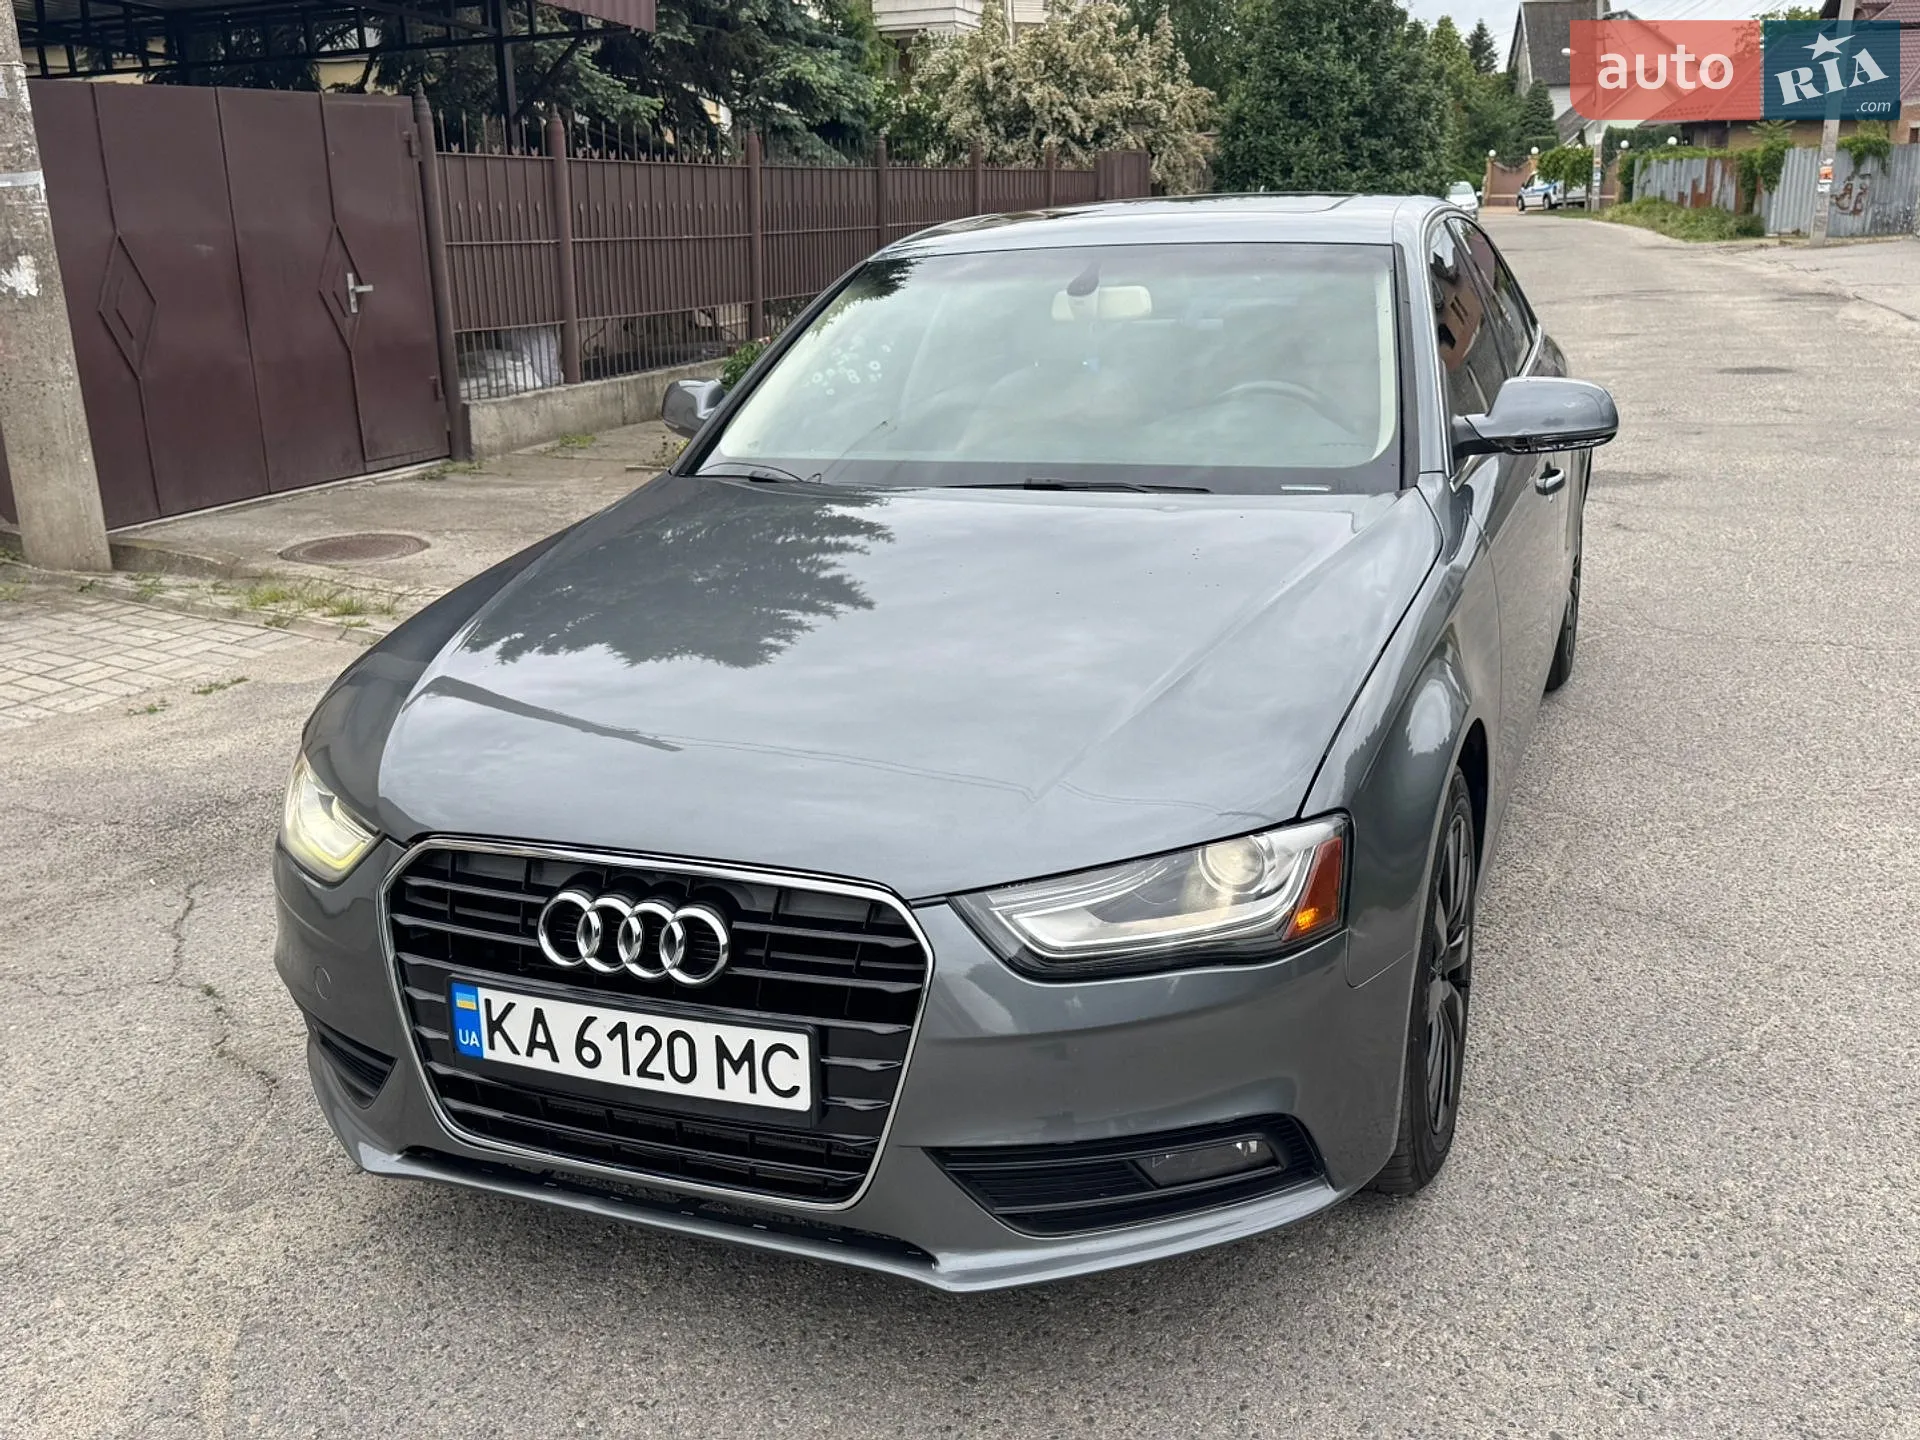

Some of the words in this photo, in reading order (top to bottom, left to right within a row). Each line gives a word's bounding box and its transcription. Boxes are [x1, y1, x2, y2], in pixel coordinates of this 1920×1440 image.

[459, 1028, 480, 1048] UA
[484, 998, 560, 1064] KA
[574, 1015, 697, 1084] 6120
[714, 1034, 800, 1099] MC
